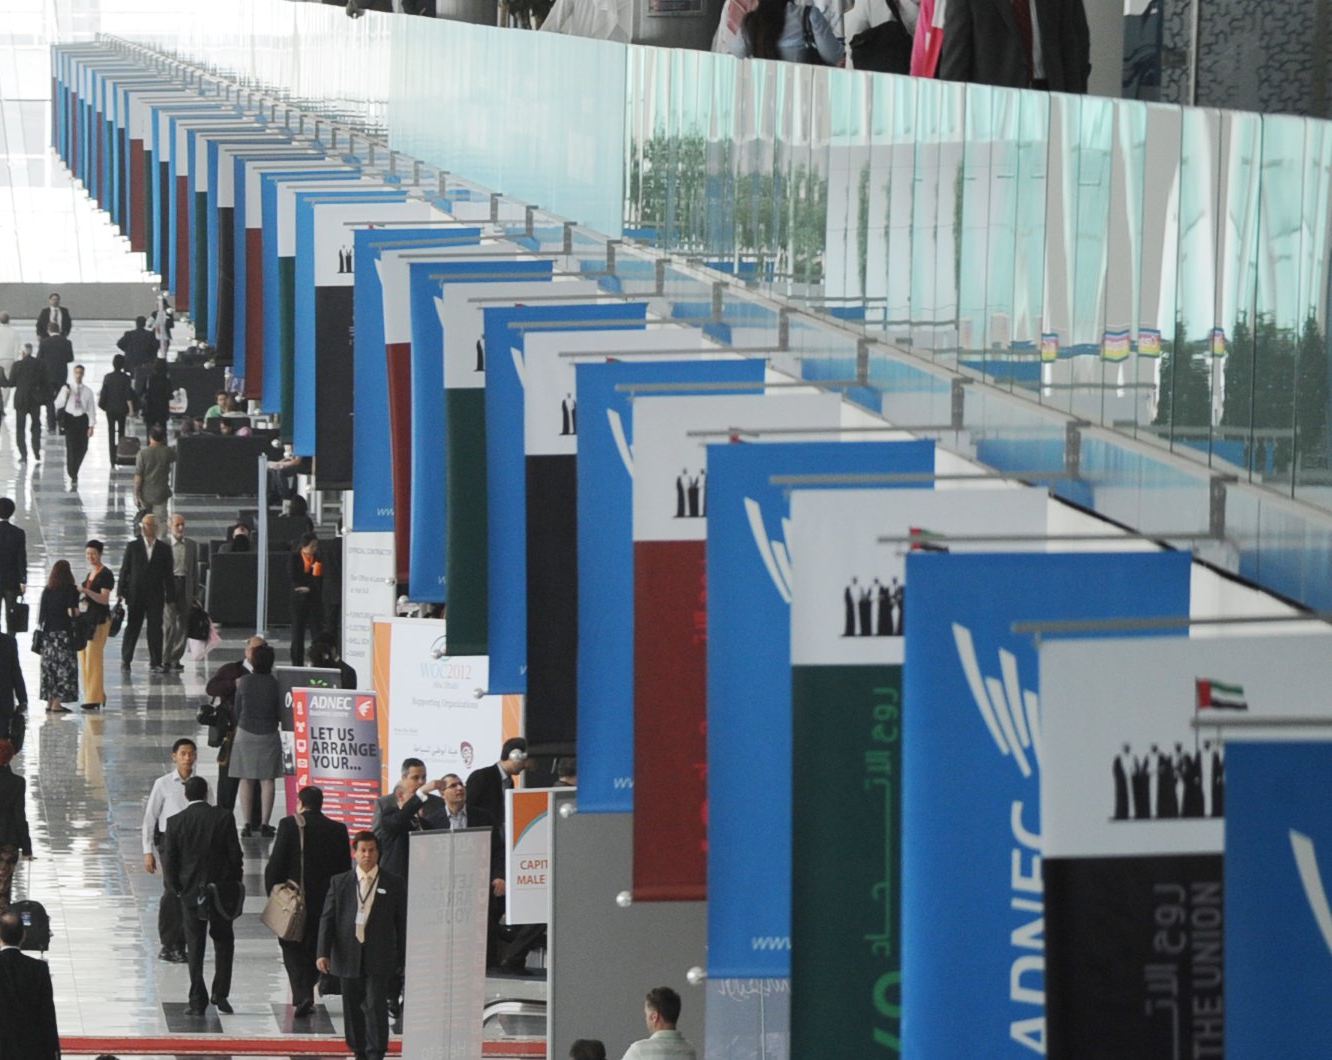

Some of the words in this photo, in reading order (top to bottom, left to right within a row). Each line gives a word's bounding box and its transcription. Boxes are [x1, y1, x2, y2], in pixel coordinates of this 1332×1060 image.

[309, 695, 352, 711] ADNEC
[310, 726, 334, 742] LET
[337, 728, 355, 743] US
[311, 740, 378, 758] ARRANGE
[312, 755, 362, 771] YOUR...
[517, 874, 546, 885] MALE
[1009, 800, 1048, 1056] ADNEC
[1191, 881, 1224, 989] UNION
